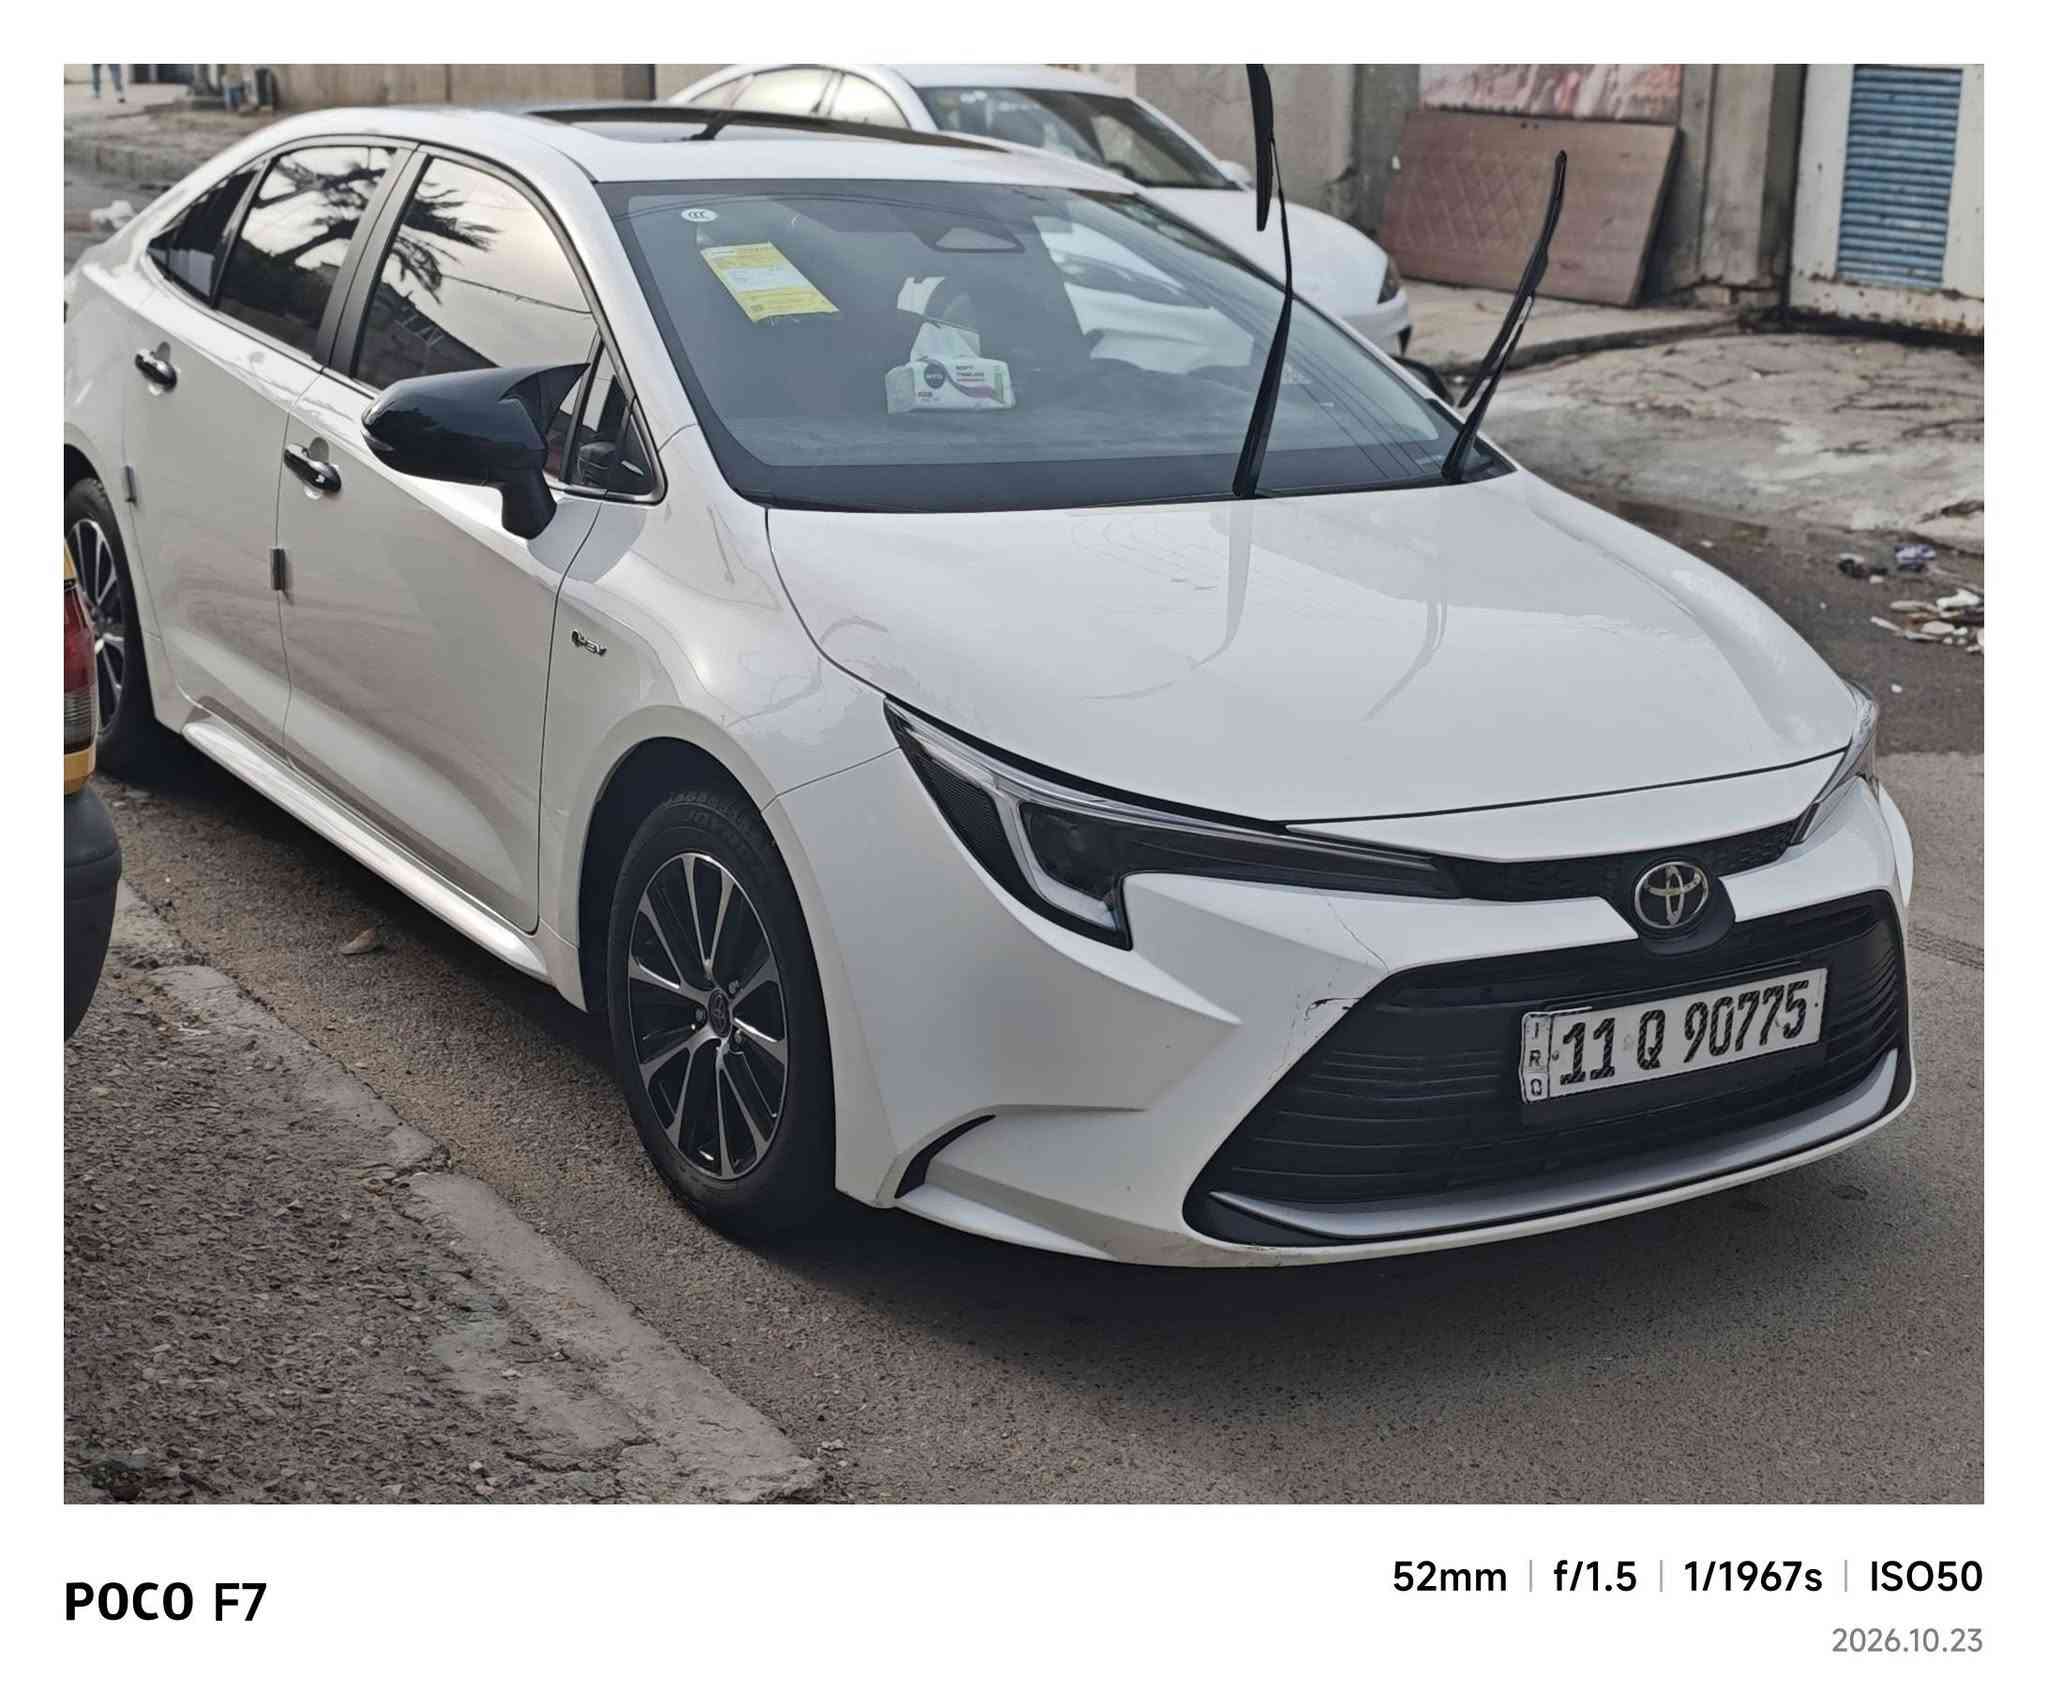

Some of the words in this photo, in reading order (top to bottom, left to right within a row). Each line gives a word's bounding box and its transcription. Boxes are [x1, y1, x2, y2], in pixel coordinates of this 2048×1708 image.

[1559, 1017, 1616, 1086] 11
[1636, 1009, 1667, 1071] Q
[1683, 979, 1810, 1064] 90775
